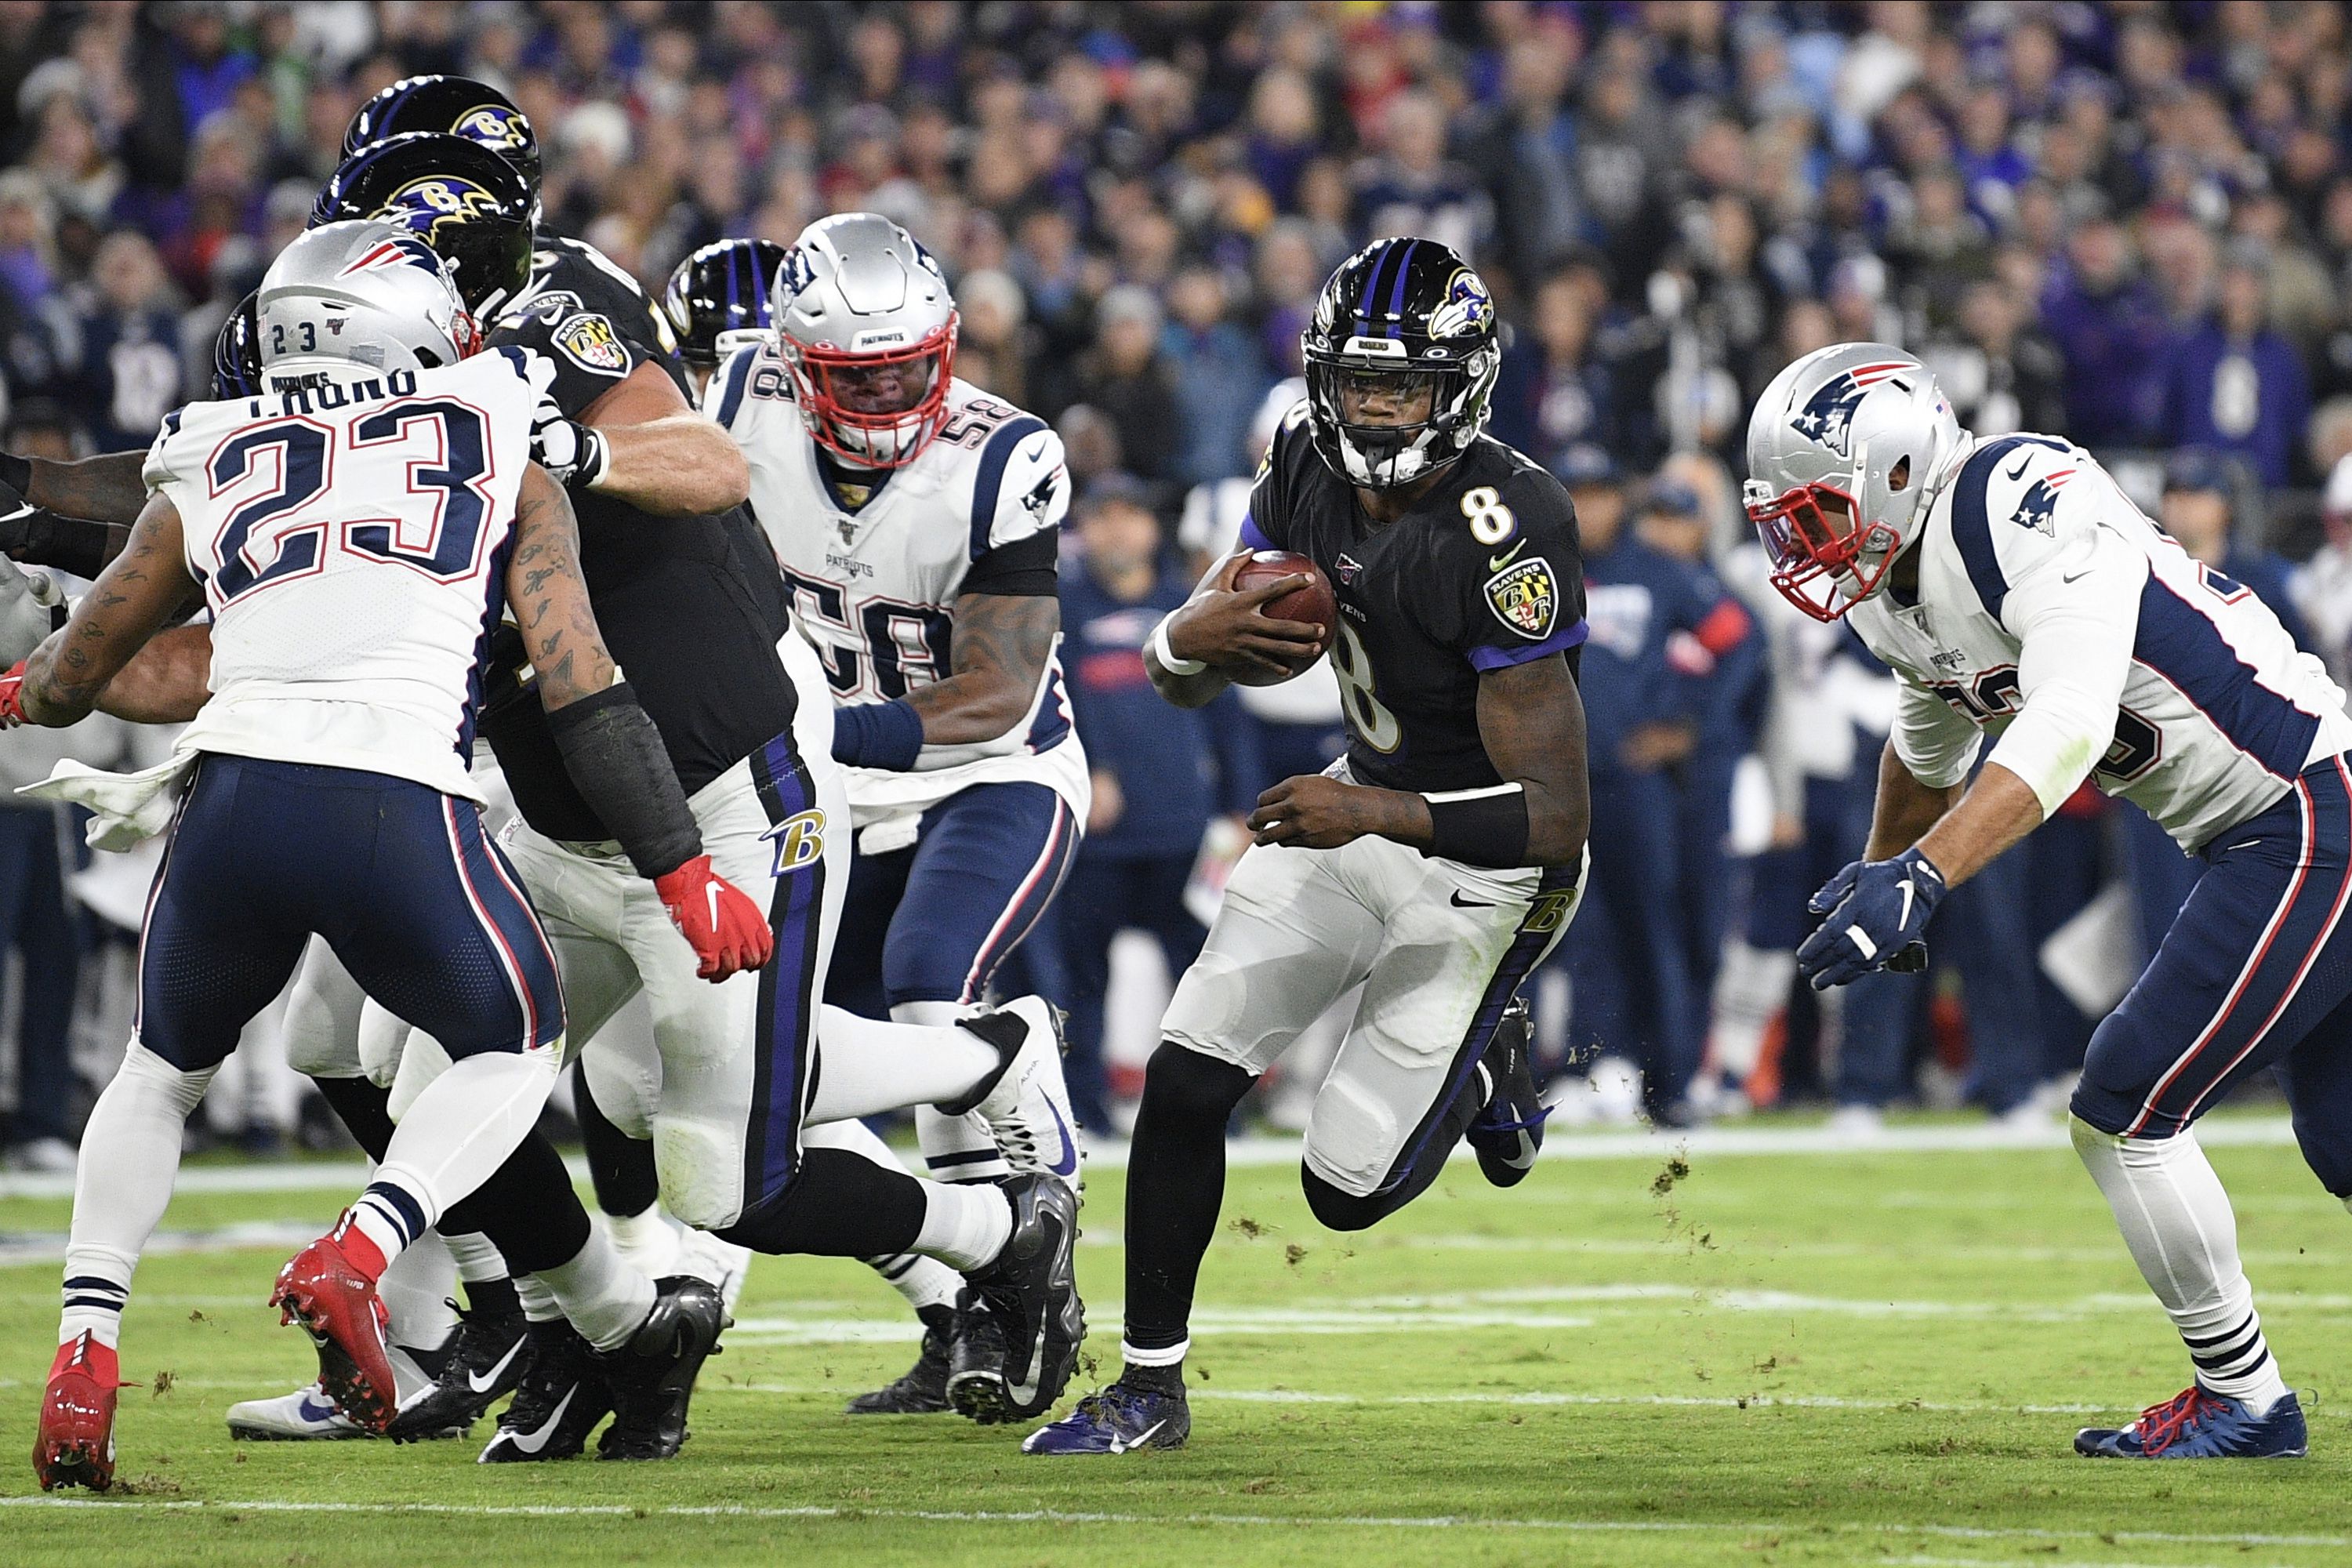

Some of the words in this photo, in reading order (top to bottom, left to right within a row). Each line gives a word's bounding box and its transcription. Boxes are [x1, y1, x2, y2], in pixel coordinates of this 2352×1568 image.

[400, 181, 462, 212] B
[272, 321, 316, 355] 23
[862, 332, 904, 347] PATRIOTS
[936, 398, 1022, 450] 58
[205, 395, 495, 612] 23
[1460, 485, 1519, 546] 8
[826, 554, 873, 578] PATRIOTS
[1490, 563, 1541, 593] RAVENS
[1502, 583, 1526, 612] B
[1530, 594, 1552, 621] R
[1329, 615, 1402, 754] 8
[757, 807, 826, 879] B
[1514, 887, 1577, 934] B
